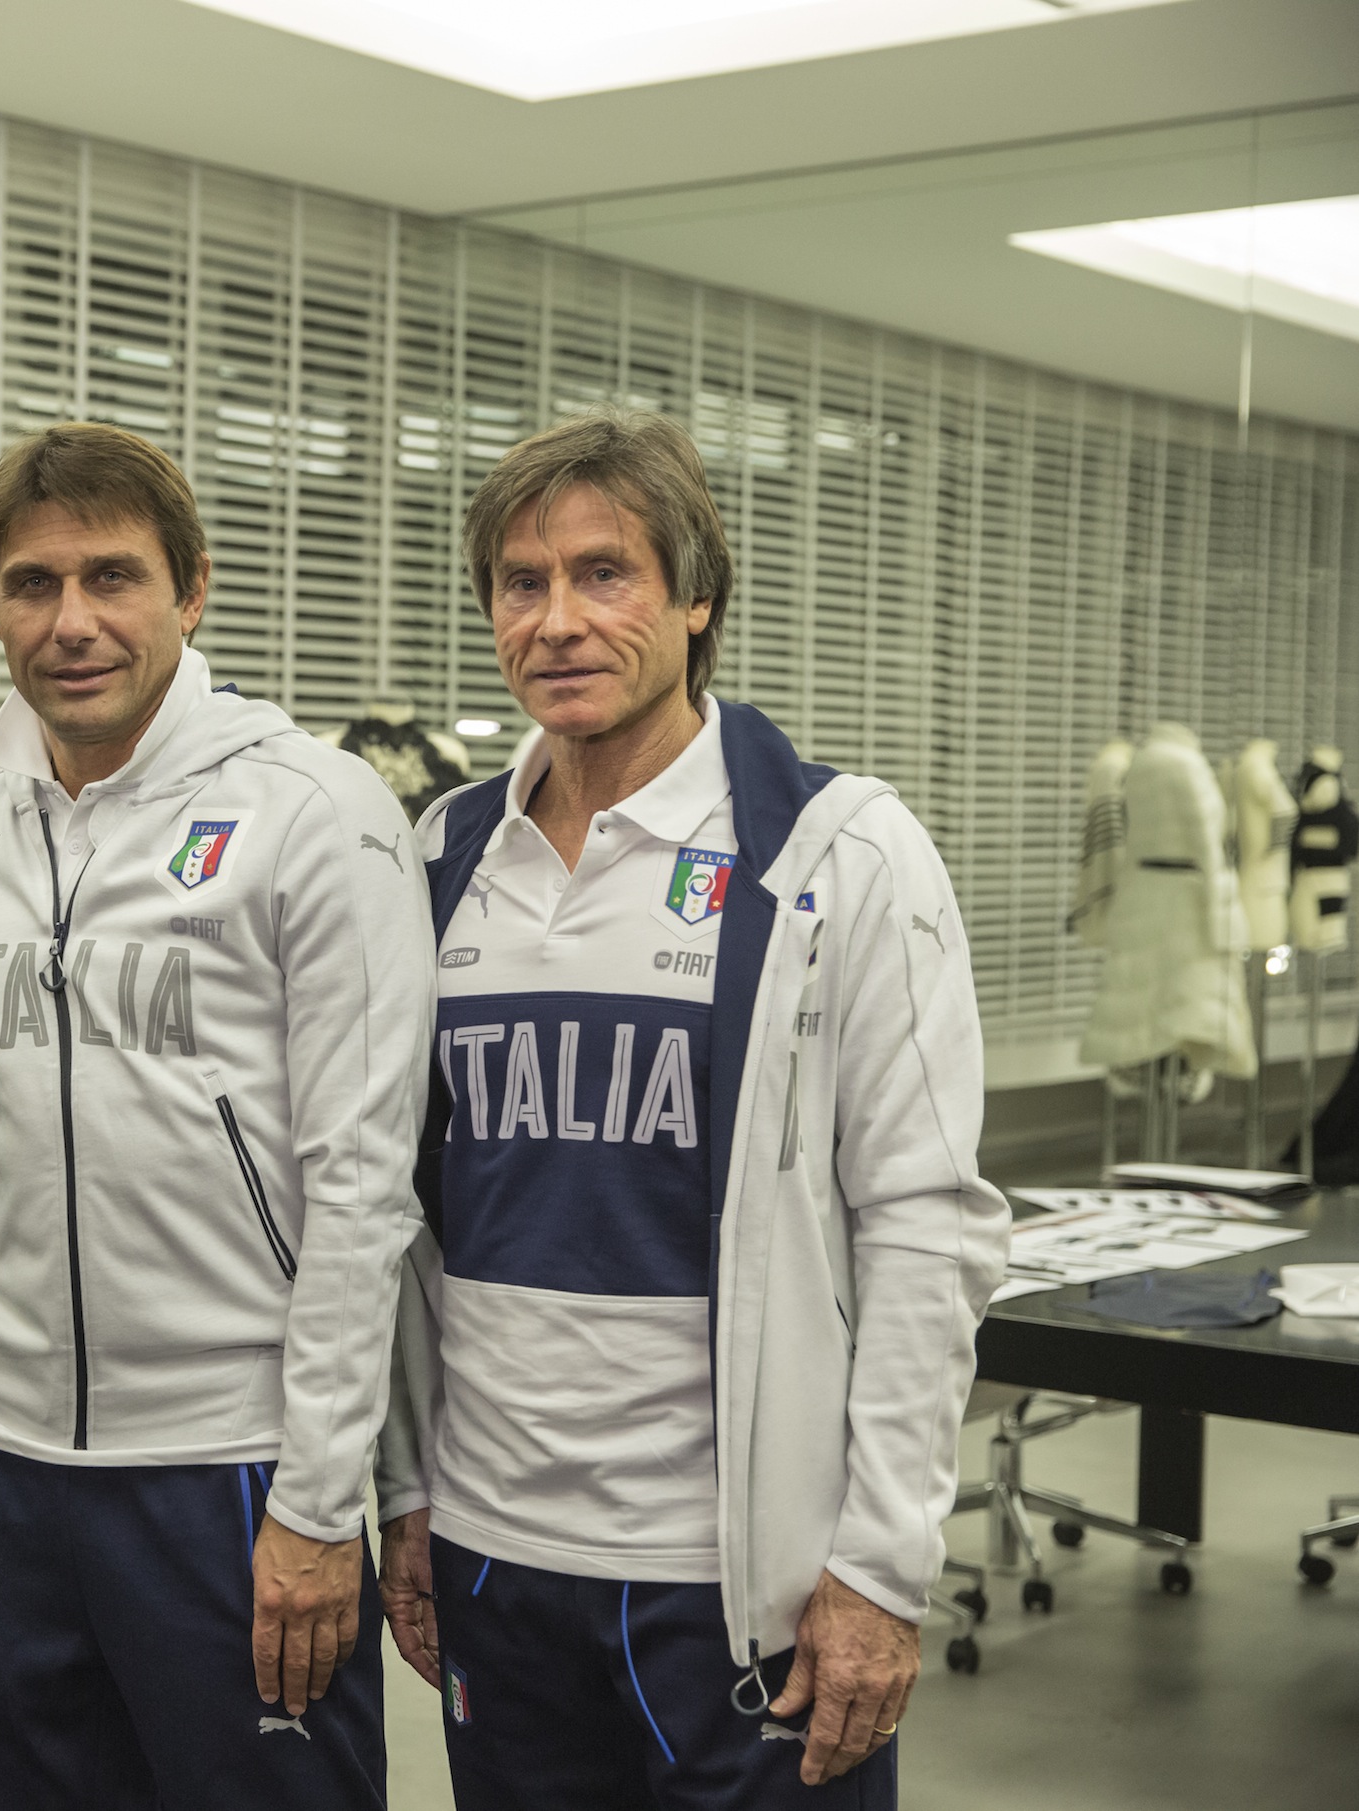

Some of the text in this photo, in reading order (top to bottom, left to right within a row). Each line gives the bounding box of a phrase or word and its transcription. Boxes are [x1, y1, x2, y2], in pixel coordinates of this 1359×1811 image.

[195, 825, 230, 834] ITALIA
[683, 852, 730, 865] ITALIA
[190, 917, 225, 941] FIAT
[456, 950, 476, 964] TIM
[673, 951, 715, 978] FIAT
[439, 1021, 698, 1148] ITALIA
